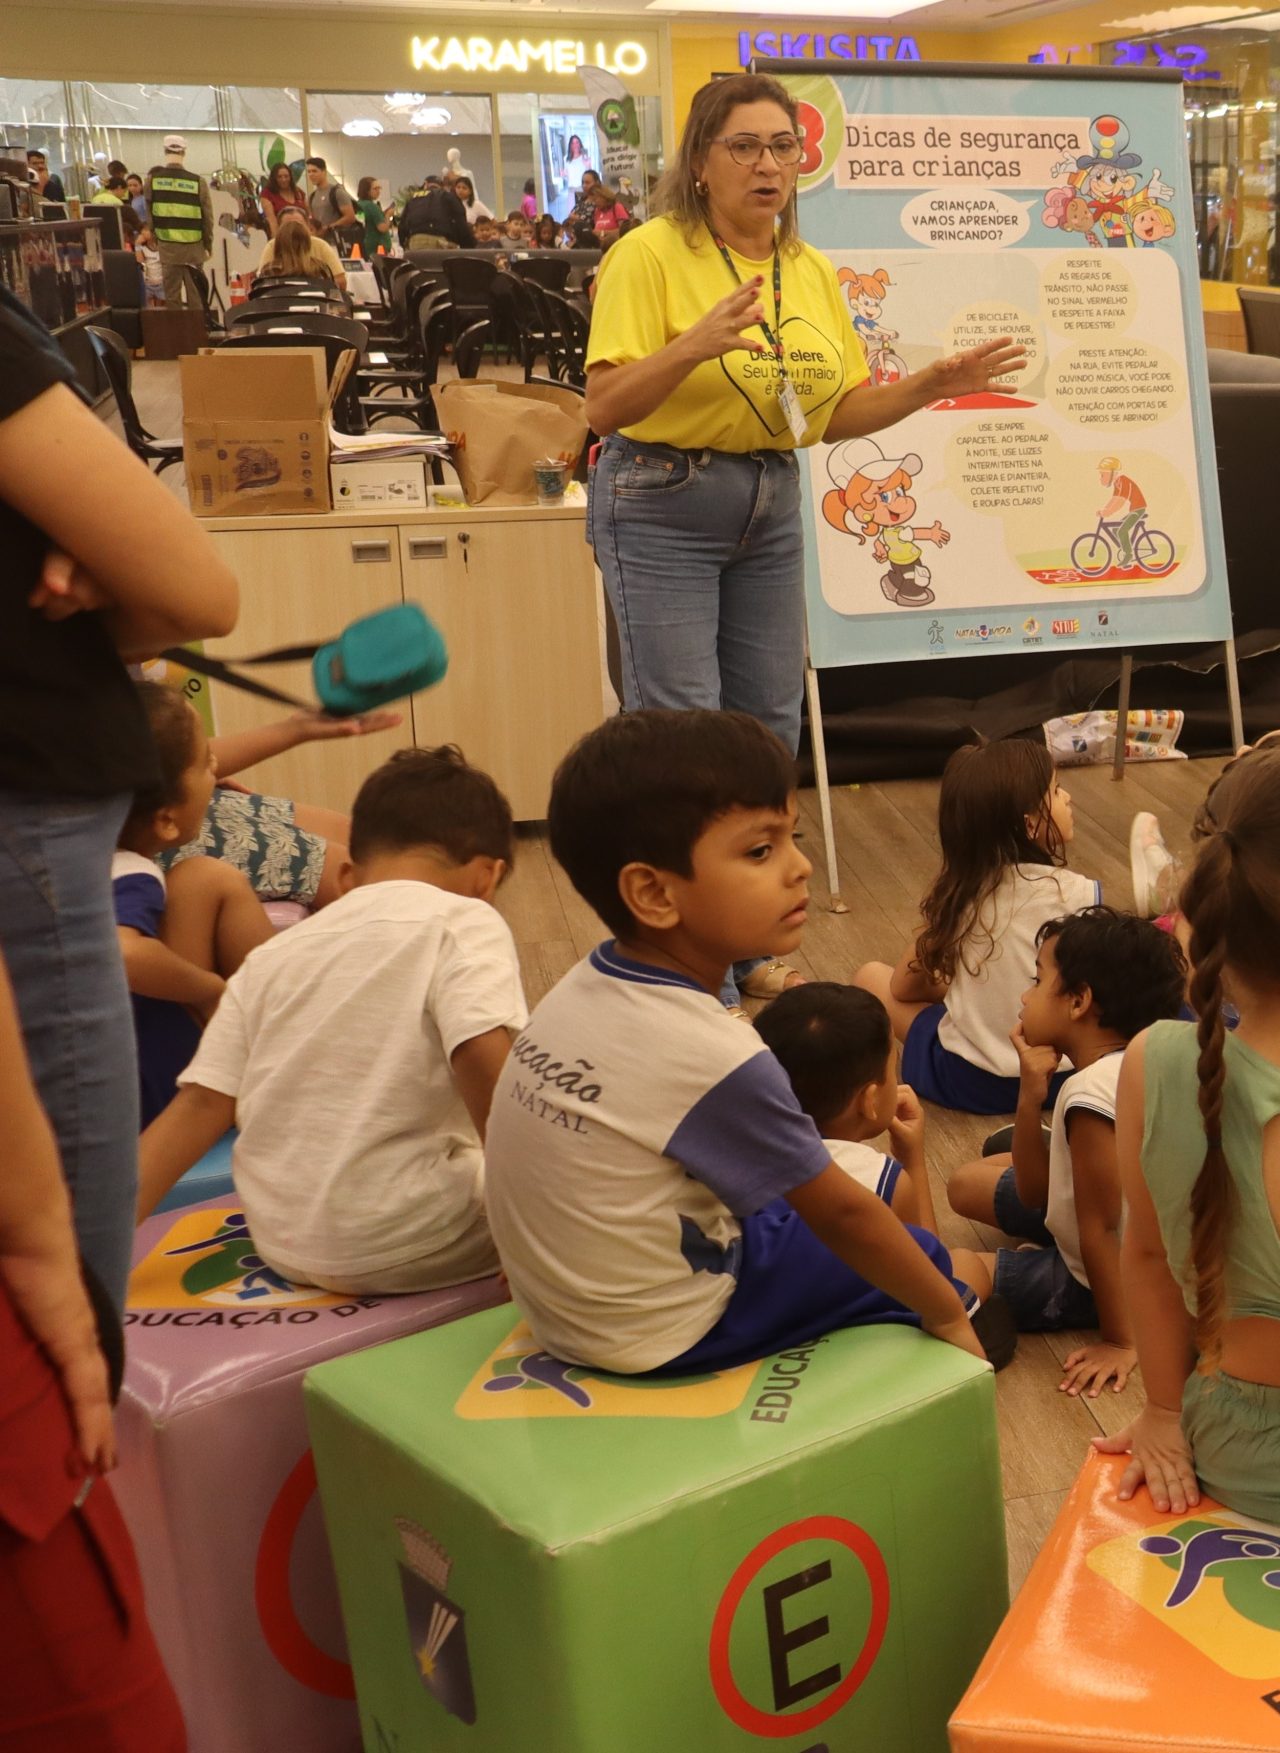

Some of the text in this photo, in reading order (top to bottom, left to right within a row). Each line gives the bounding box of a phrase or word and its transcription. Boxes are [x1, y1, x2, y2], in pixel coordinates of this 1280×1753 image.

[738, 31, 921, 66] ISKISITA
[411, 35, 648, 75] KARAMELLO
[846, 125, 1081, 153] Dicas de segurança
[848, 154, 1022, 180] para crianças
[930, 200, 999, 214] CRIANÇADA,
[912, 215, 1019, 227] VAMOS APRENDER
[930, 229, 1004, 241] BRINCANDO?
[1066, 259, 1102, 268] RESPEITE
[1059, 272, 1112, 281] AS REGRAS DE
[1044, 284, 1129, 294] TRÂNSITO, NÃO PASSE
[1047, 296, 1128, 306] NO SINAL VERMELHO
[966, 312, 1019, 321] DE BICICLETA
[1051, 309, 1126, 318] E RESPEITE A FAIXA
[953, 324, 1034, 335] UTILIZE, SE HOUVER,
[1064, 321, 1115, 330] DE PEDESTRE!
[952, 339, 960, 347] A
[1016, 337, 1037, 346] ANDE
[750, 349, 828, 364] Deselere.
[1079, 349, 1107, 358] PRESTE
[1070, 362, 1082, 370] NA
[1101, 361, 1124, 369] EVITE
[1125, 360, 1158, 369] PEDALAR
[743, 364, 768, 379] Seu
[803, 365, 837, 381] maior
[1058, 374, 1094, 383] OUVINDO
[1129, 372, 1150, 381] VOCÊ
[1151, 372, 1172, 381] PODE
[793, 381, 815, 396] ida.
[1056, 386, 1073, 396] NÃO
[1075, 387, 1100, 395] OUVIR
[1100, 386, 1130, 394] CARROS
[1068, 400, 1168, 412] ATENÇÃO COM PORTAS DE
[1079, 415, 1110, 424] CARROS
[1111, 414, 1121, 423] SE
[978, 422, 1025, 432] USE SEMPRE
[1001, 435, 1013, 444] AO
[1014, 434, 1049, 443] PEDALAR
[1002, 447, 1017, 456] USE
[1018, 447, 1042, 456] LUZES
[967, 459, 1043, 470] INTERMITENTES NA
[961, 473, 999, 483] TRASEIRA
[1000, 473, 1006, 482] E
[970, 484, 1045, 495] COLETE REFLETIVO
[973, 499, 978, 508] E
[980, 498, 1011, 507] ROUPAS
[511, 1033, 603, 1104] ucação
[510, 1081, 590, 1135] NATAL
[124, 1300, 383, 1329] DUCAÇÃO DE
[763, 1559, 842, 1713] E
